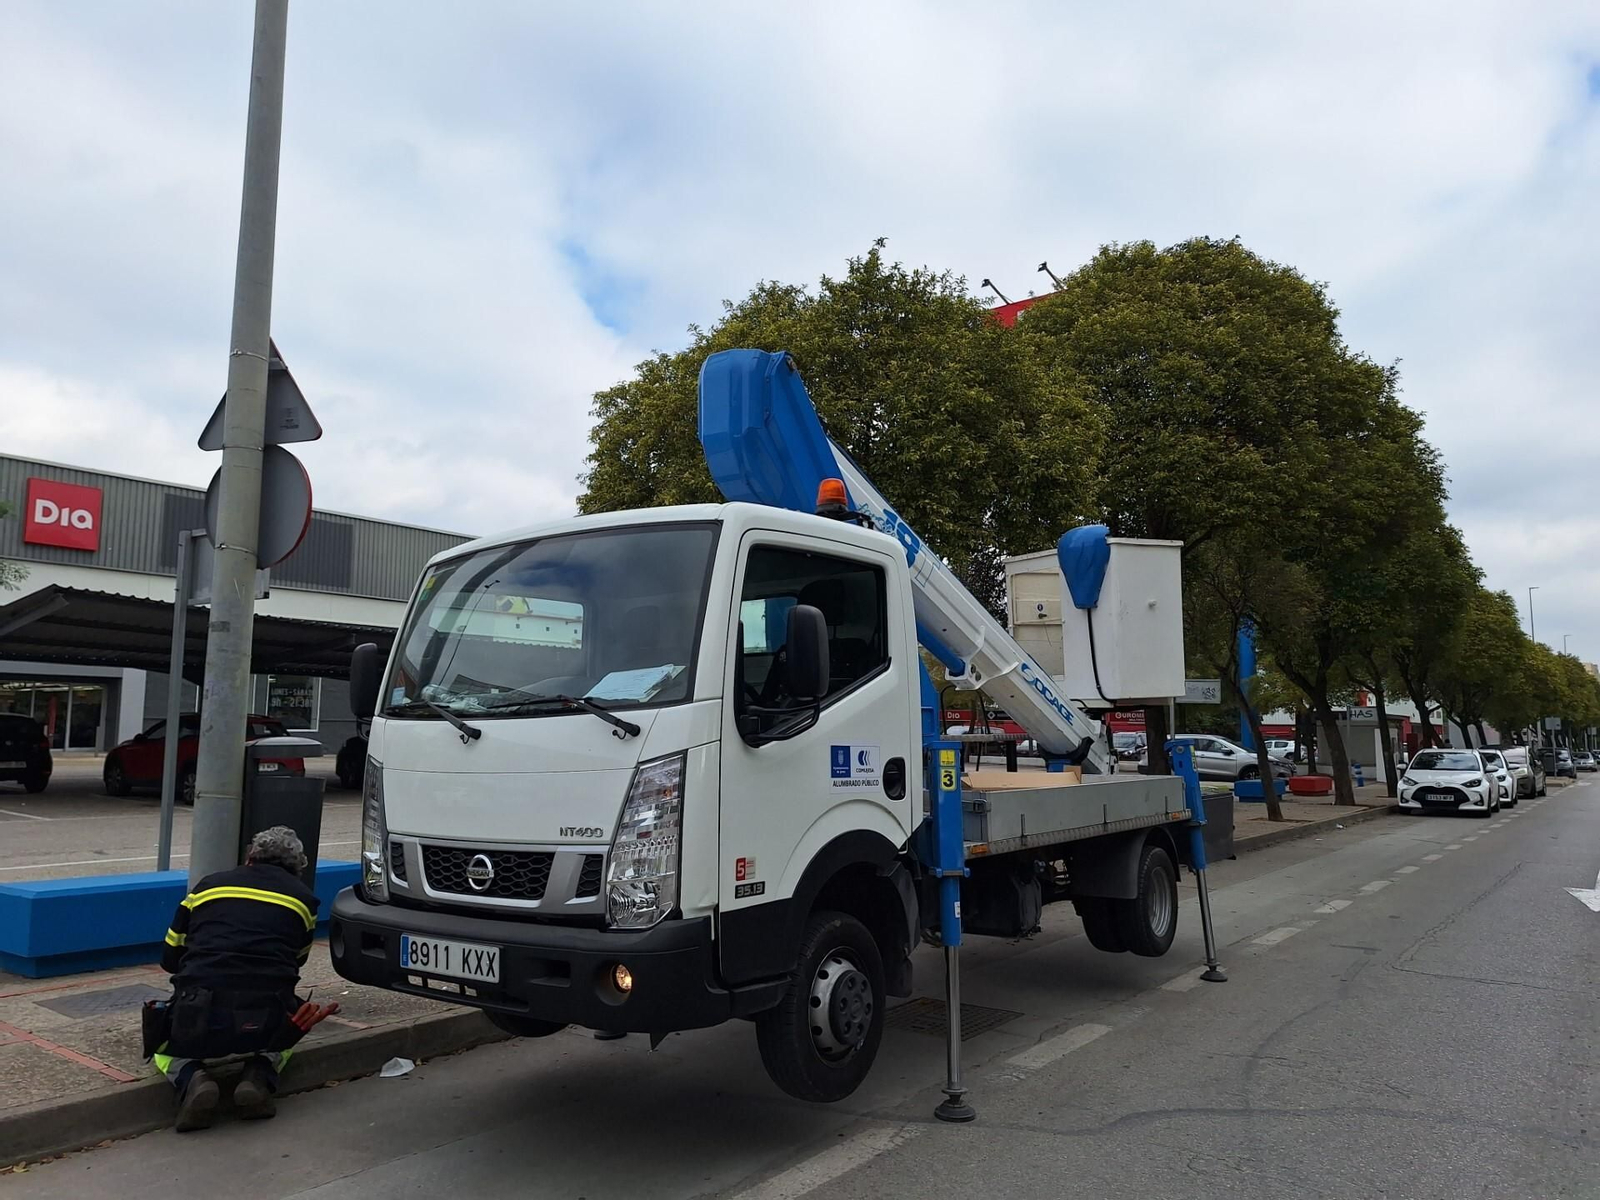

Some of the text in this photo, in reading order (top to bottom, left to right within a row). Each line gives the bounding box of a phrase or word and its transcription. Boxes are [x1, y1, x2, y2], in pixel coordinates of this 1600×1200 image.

[1021, 662, 1075, 726] SOCAGE
[942, 774, 954, 788] 3
[559, 827, 603, 838] NT400
[467, 868, 490, 878] NISSAN
[737, 862, 744, 877] 5
[737, 883, 763, 897] 35.13
[409, 941, 449, 970] 8911
[461, 947, 497, 978] KXX
